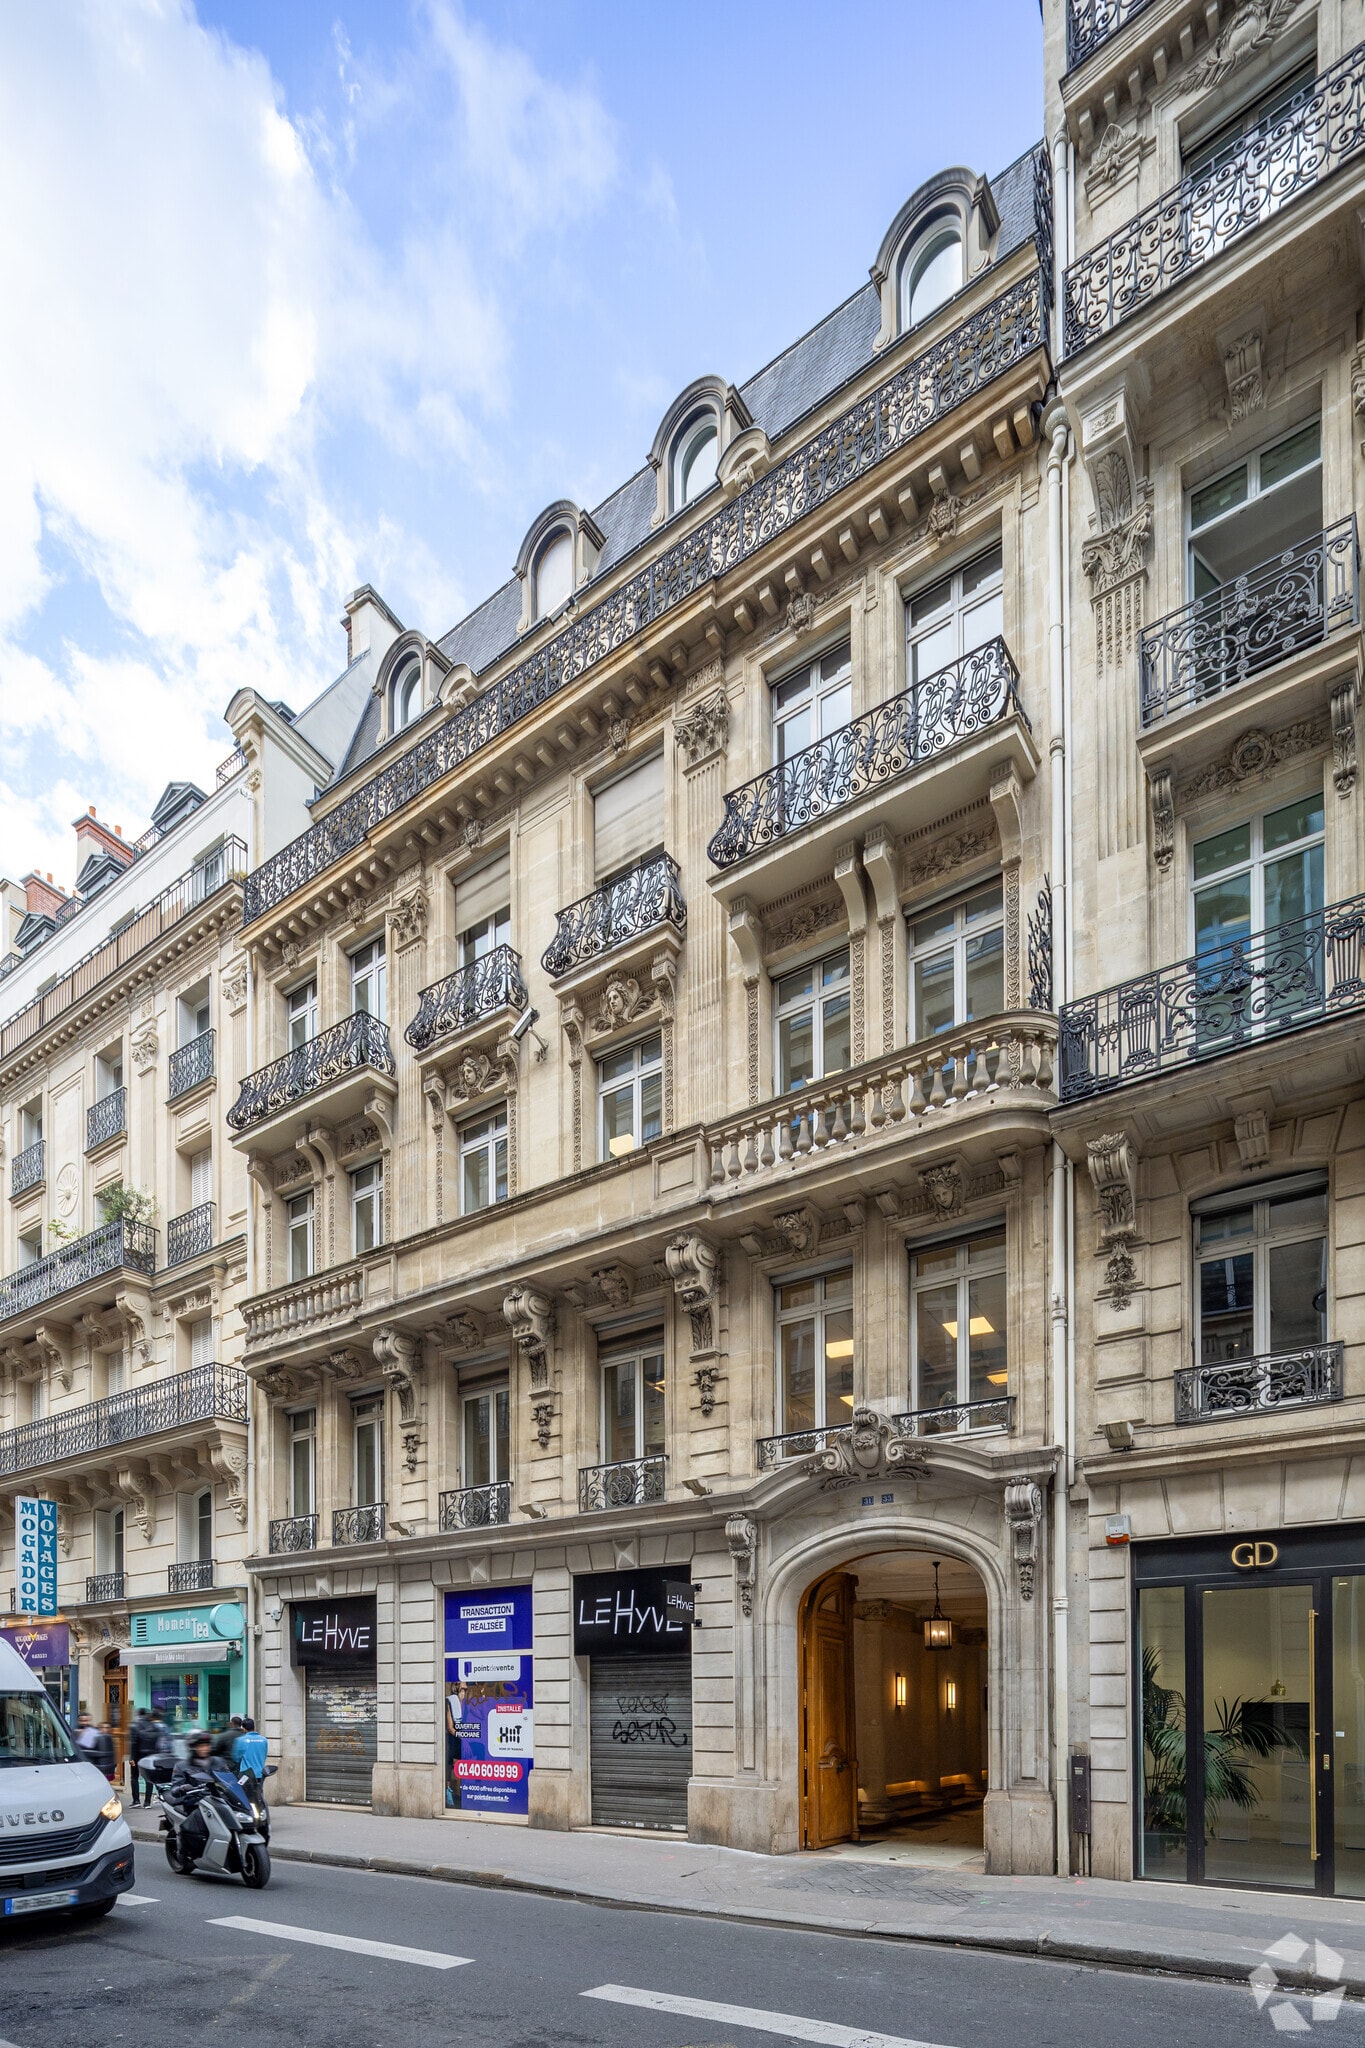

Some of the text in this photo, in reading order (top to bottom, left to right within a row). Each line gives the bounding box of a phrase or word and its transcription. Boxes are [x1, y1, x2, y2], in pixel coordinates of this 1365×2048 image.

[20, 1502, 37, 1611] MOGADOR
[40, 1503, 55, 1611] VOYAGES
[1231, 1541, 1278, 1567] GD
[462, 1605, 512, 1617] TRANSACTION
[470, 1620, 504, 1631] RÉALISÉE
[473, 1664, 515, 1674] pointdevente
